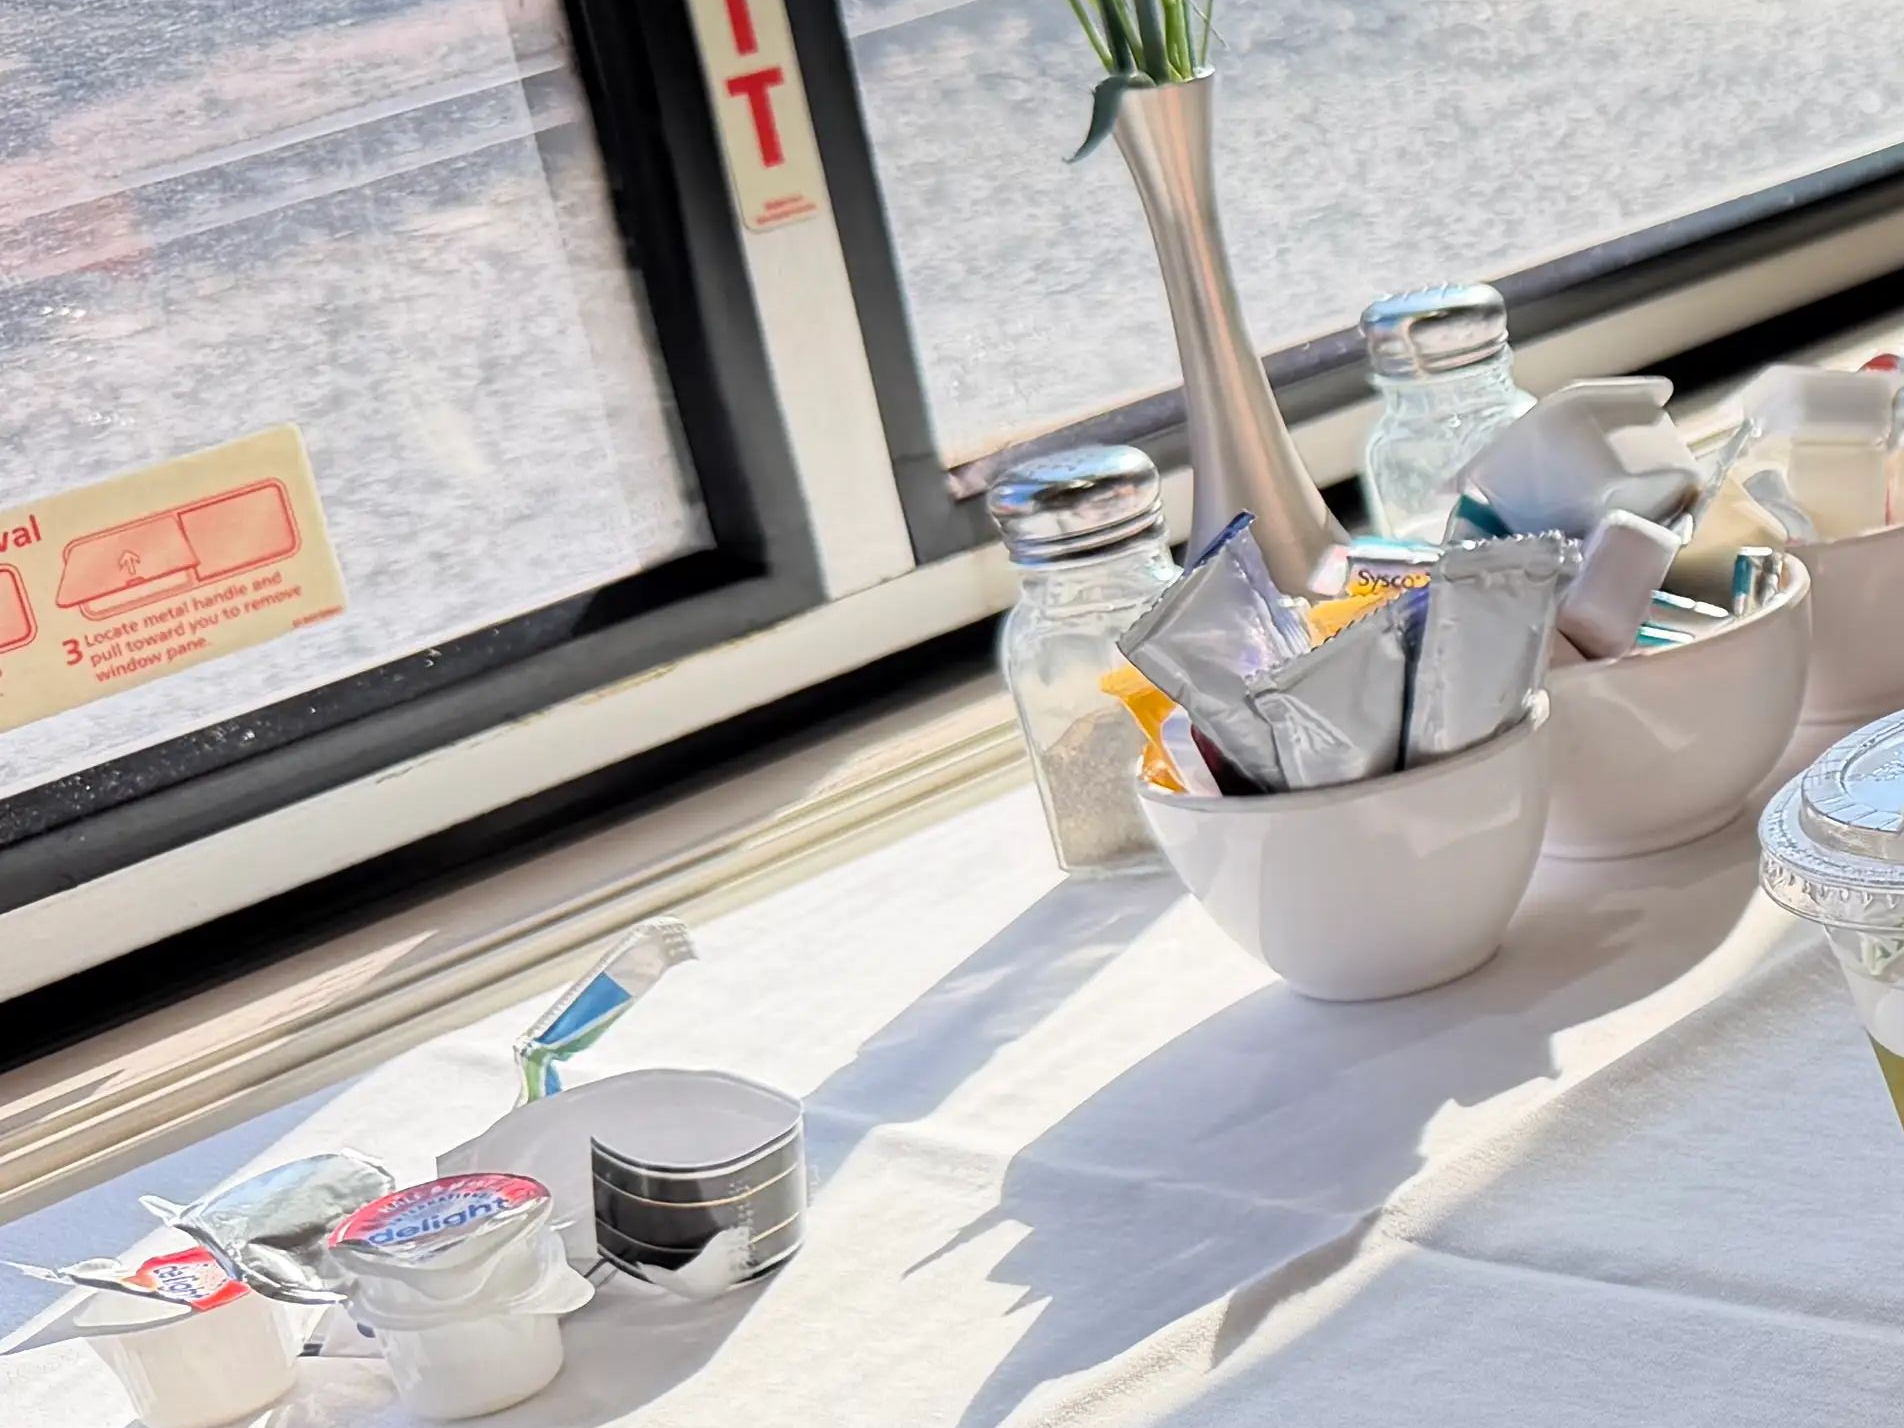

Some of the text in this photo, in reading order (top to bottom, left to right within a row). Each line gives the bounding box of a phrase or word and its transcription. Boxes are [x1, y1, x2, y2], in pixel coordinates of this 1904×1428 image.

[1357, 570, 1415, 598] Sysco
[84, 571, 283, 647] Locate metal handle and
[90, 584, 303, 668] pull toward you to remove
[62, 638, 84, 666] 3
[94, 653, 163, 683] window
[368, 1197, 510, 1246] delight
